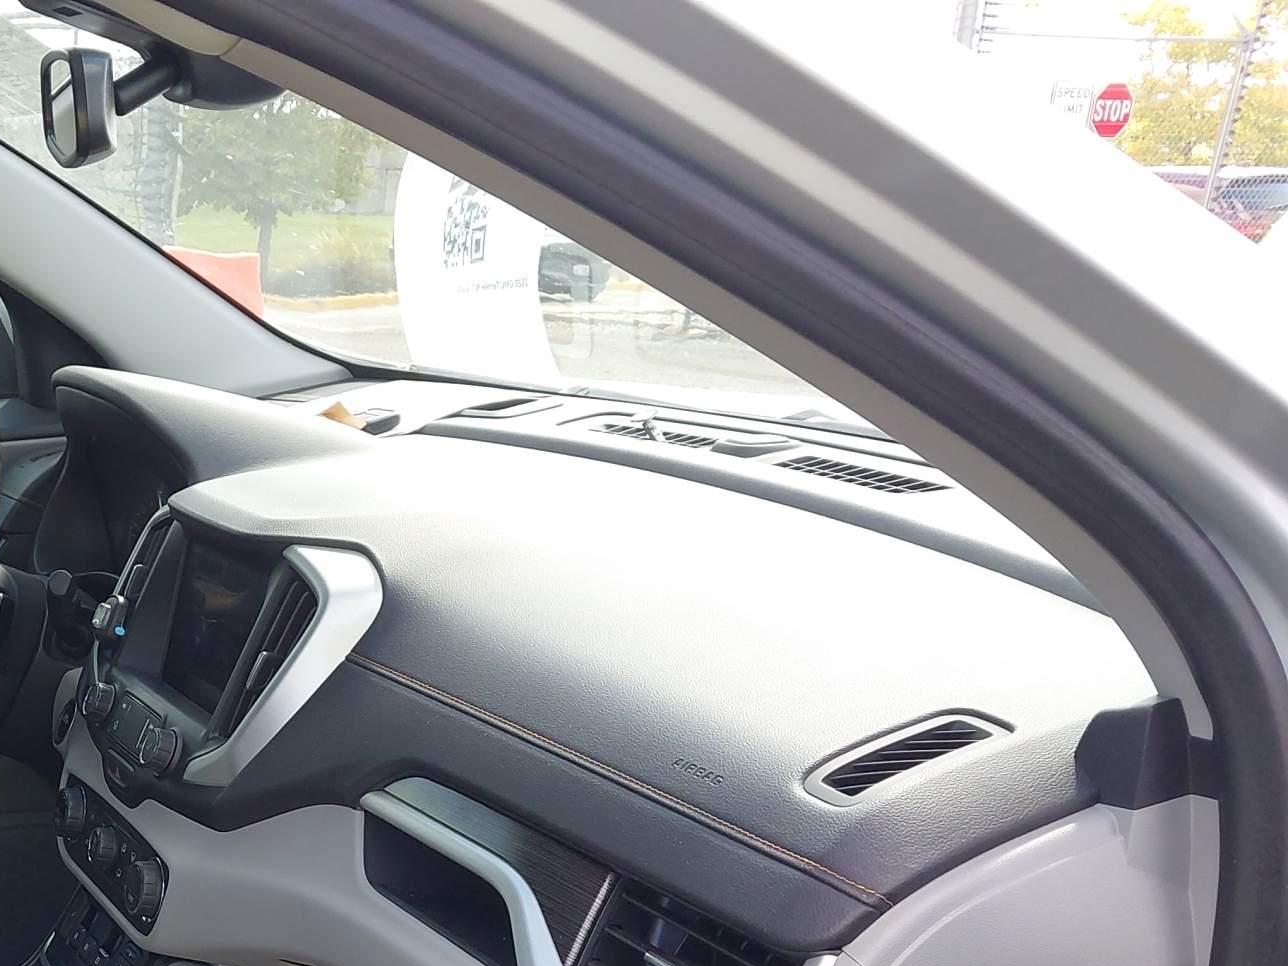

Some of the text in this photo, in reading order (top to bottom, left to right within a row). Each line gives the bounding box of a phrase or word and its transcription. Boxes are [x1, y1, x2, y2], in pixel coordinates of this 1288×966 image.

[1057, 87, 1090, 99] SPEED
[1059, 103, 1084, 114] IMIT
[1094, 99, 1132, 122] STOP
[671, 757, 725, 787] AIRBAG
